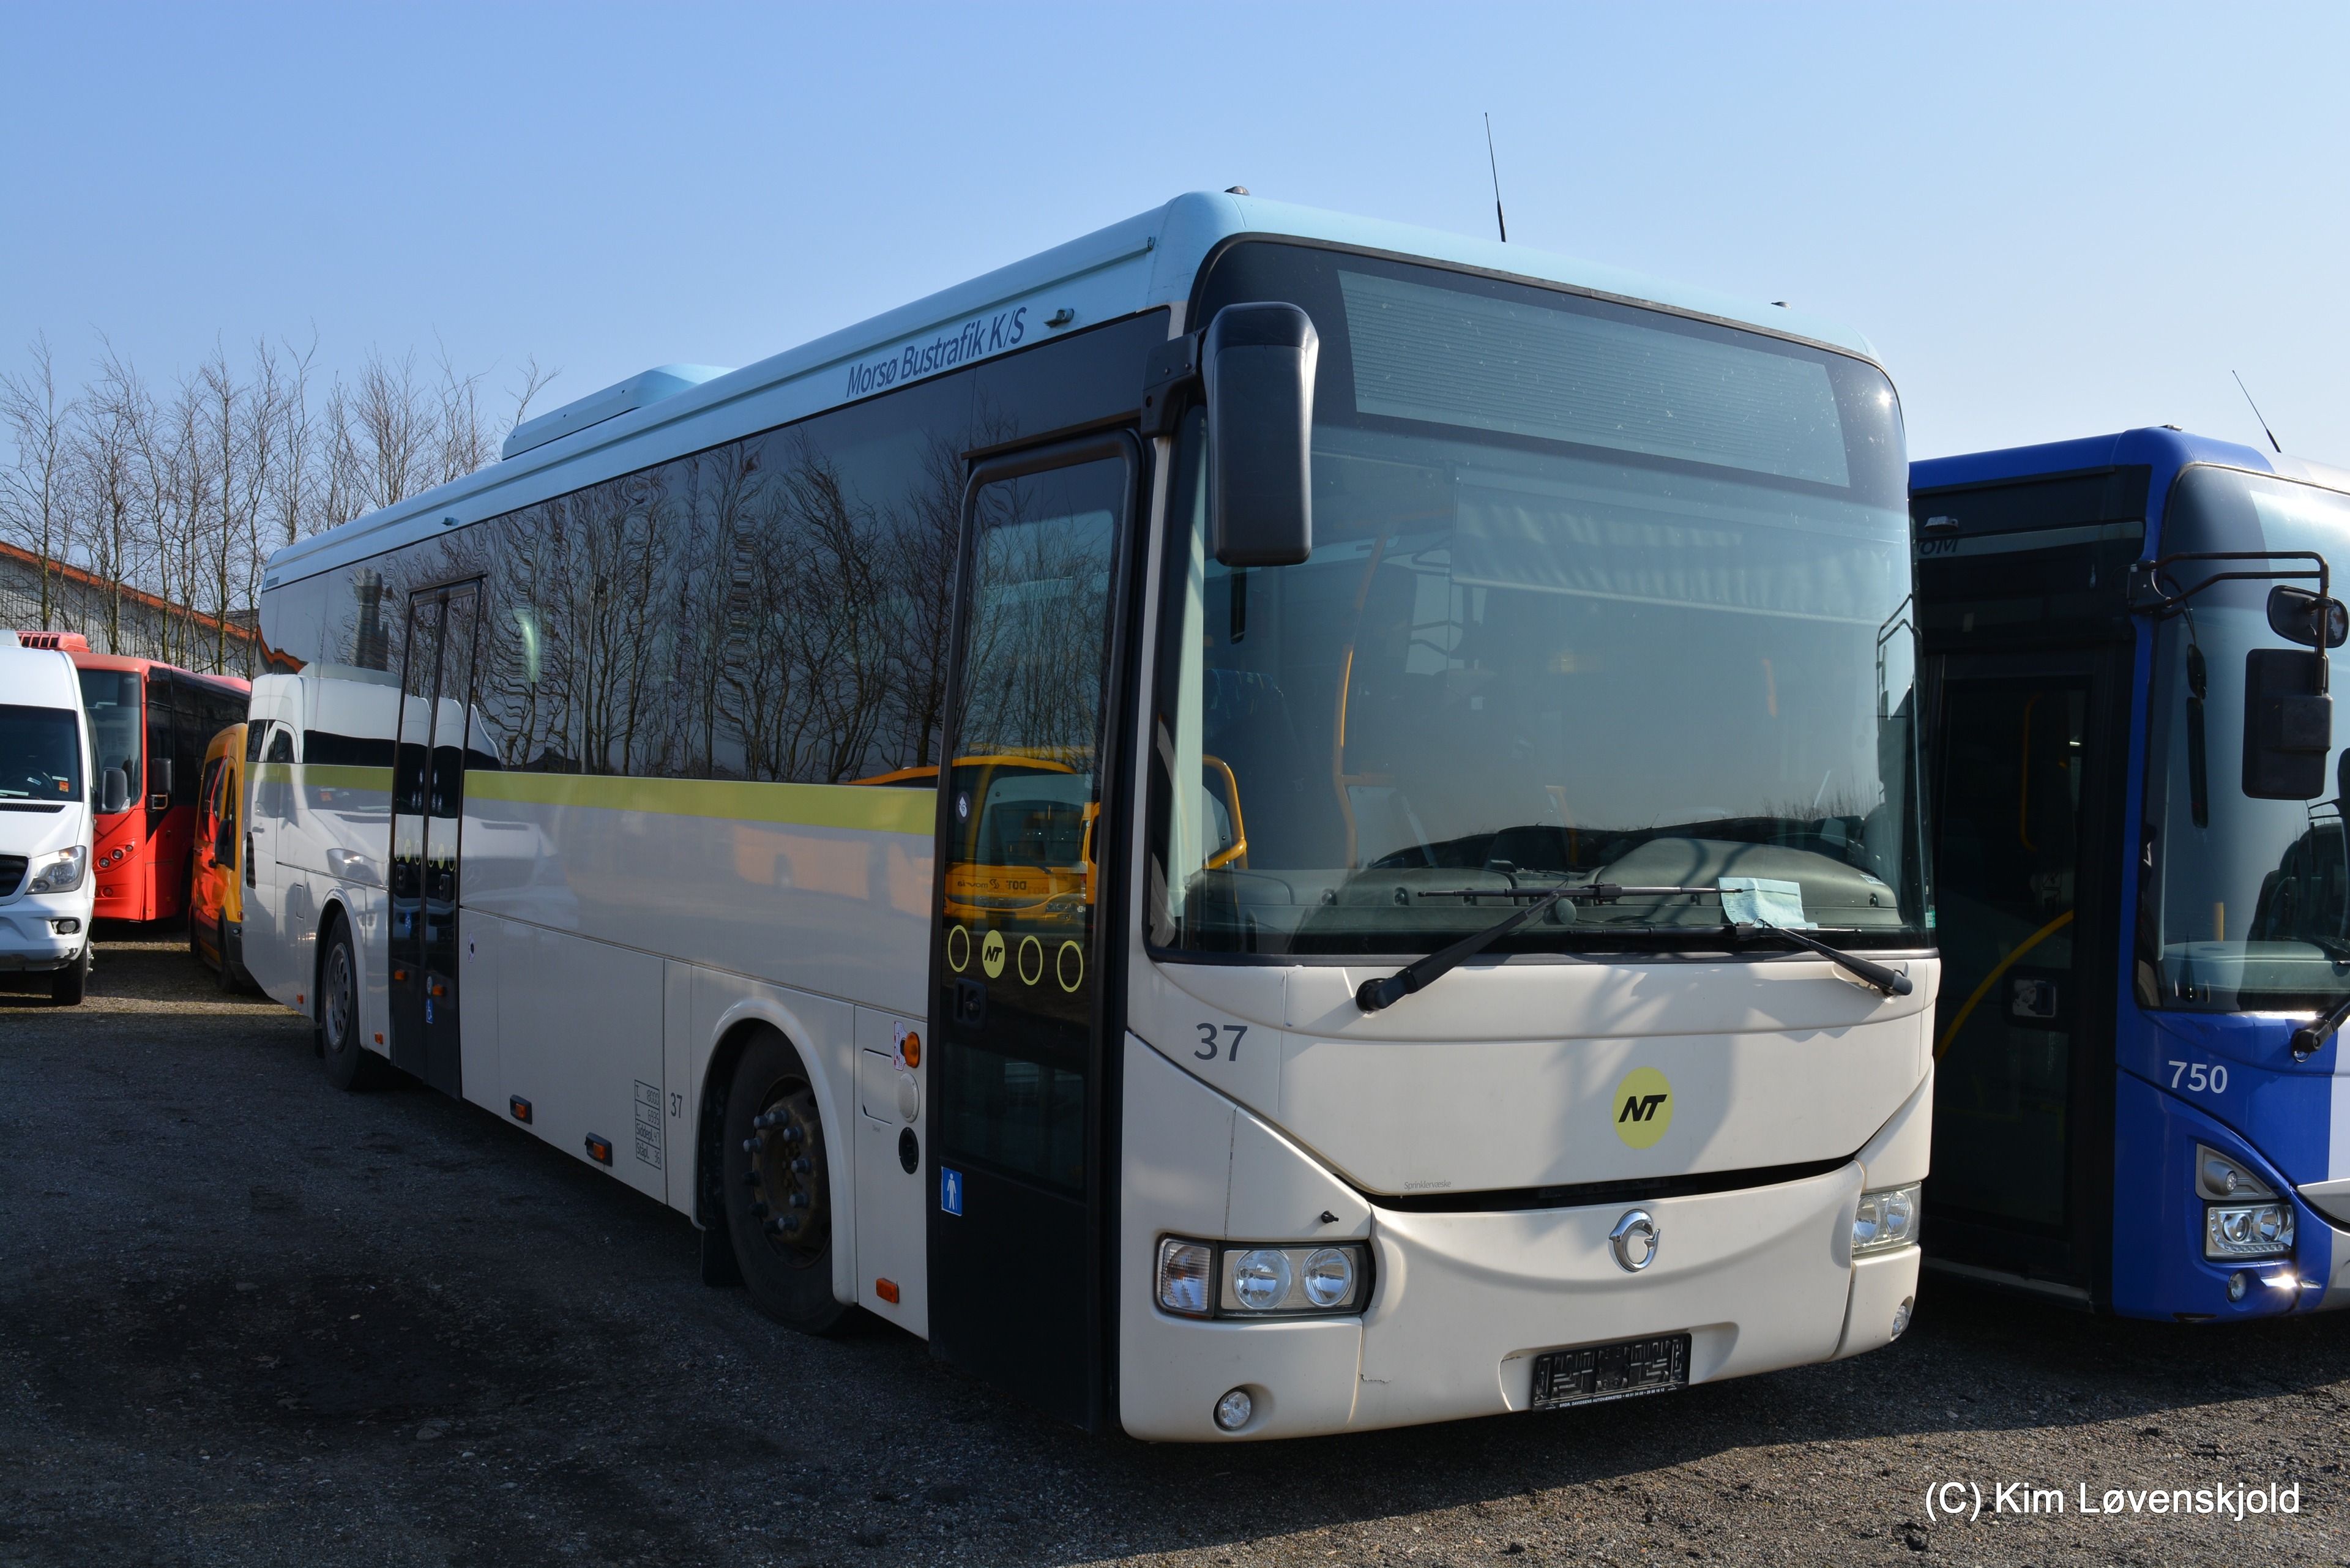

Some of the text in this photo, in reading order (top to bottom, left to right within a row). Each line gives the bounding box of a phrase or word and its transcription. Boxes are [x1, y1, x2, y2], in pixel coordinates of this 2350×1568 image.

[846, 307, 1027, 398] Morsø Bustrafik K/S
[984, 946, 1003, 962] NT
[1193, 1023, 1248, 1062] 37
[2168, 1060, 2228, 1094] 750
[671, 1092, 682, 1119] 37
[1618, 1094, 1668, 1123] NT
[1404, 1180, 1452, 1191] Sprinklervæske
